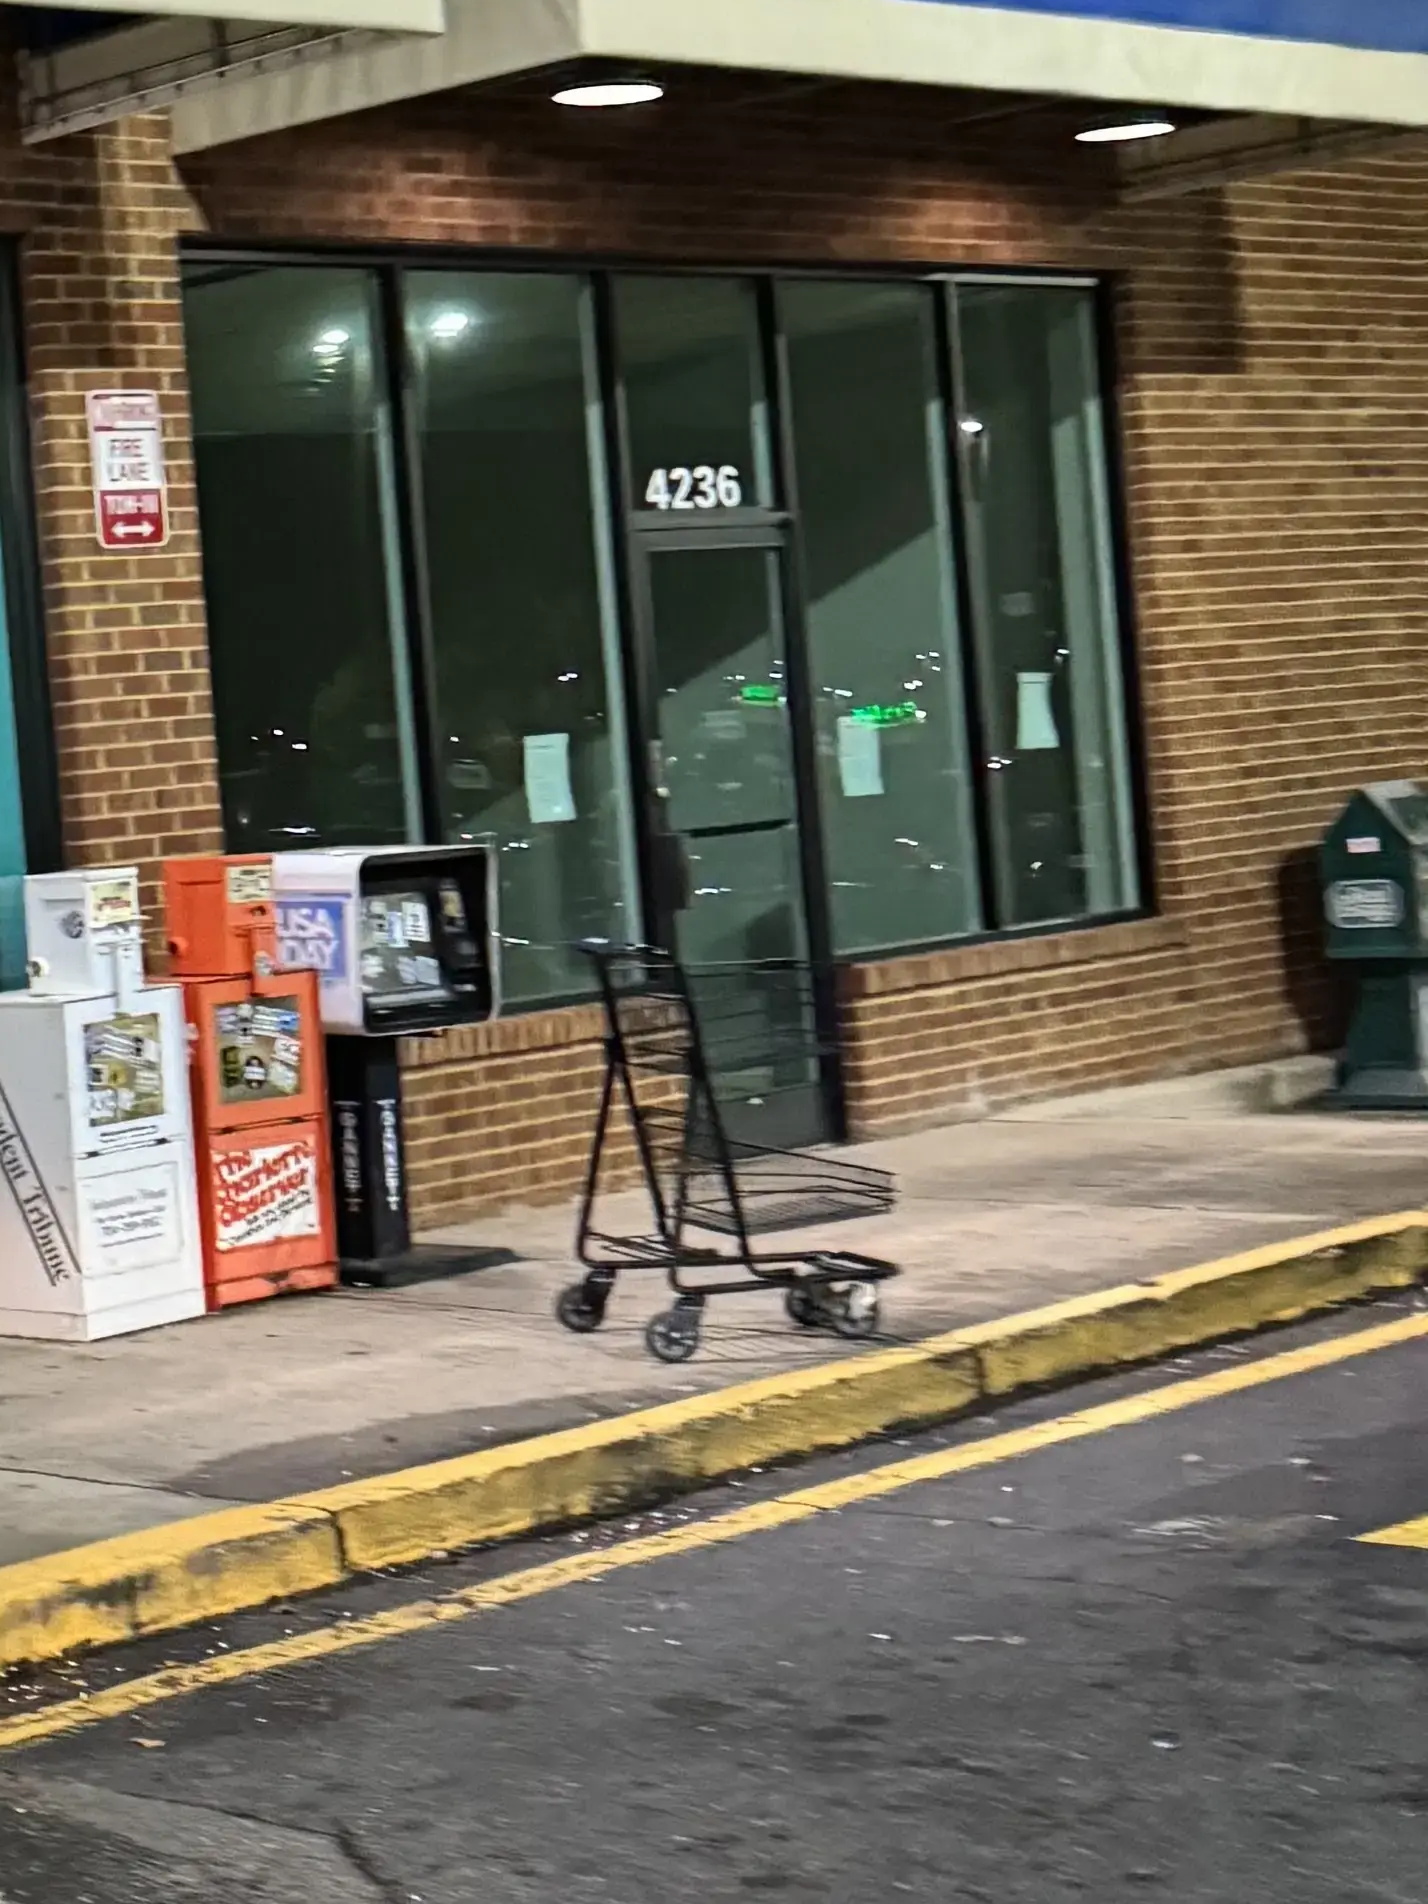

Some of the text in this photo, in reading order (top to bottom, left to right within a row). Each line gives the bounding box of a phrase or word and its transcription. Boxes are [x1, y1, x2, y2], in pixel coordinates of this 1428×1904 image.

[645, 465, 741, 510] 4236
[275, 907, 335, 938] USA
[20, 1184, 72, 1282] Tribune
